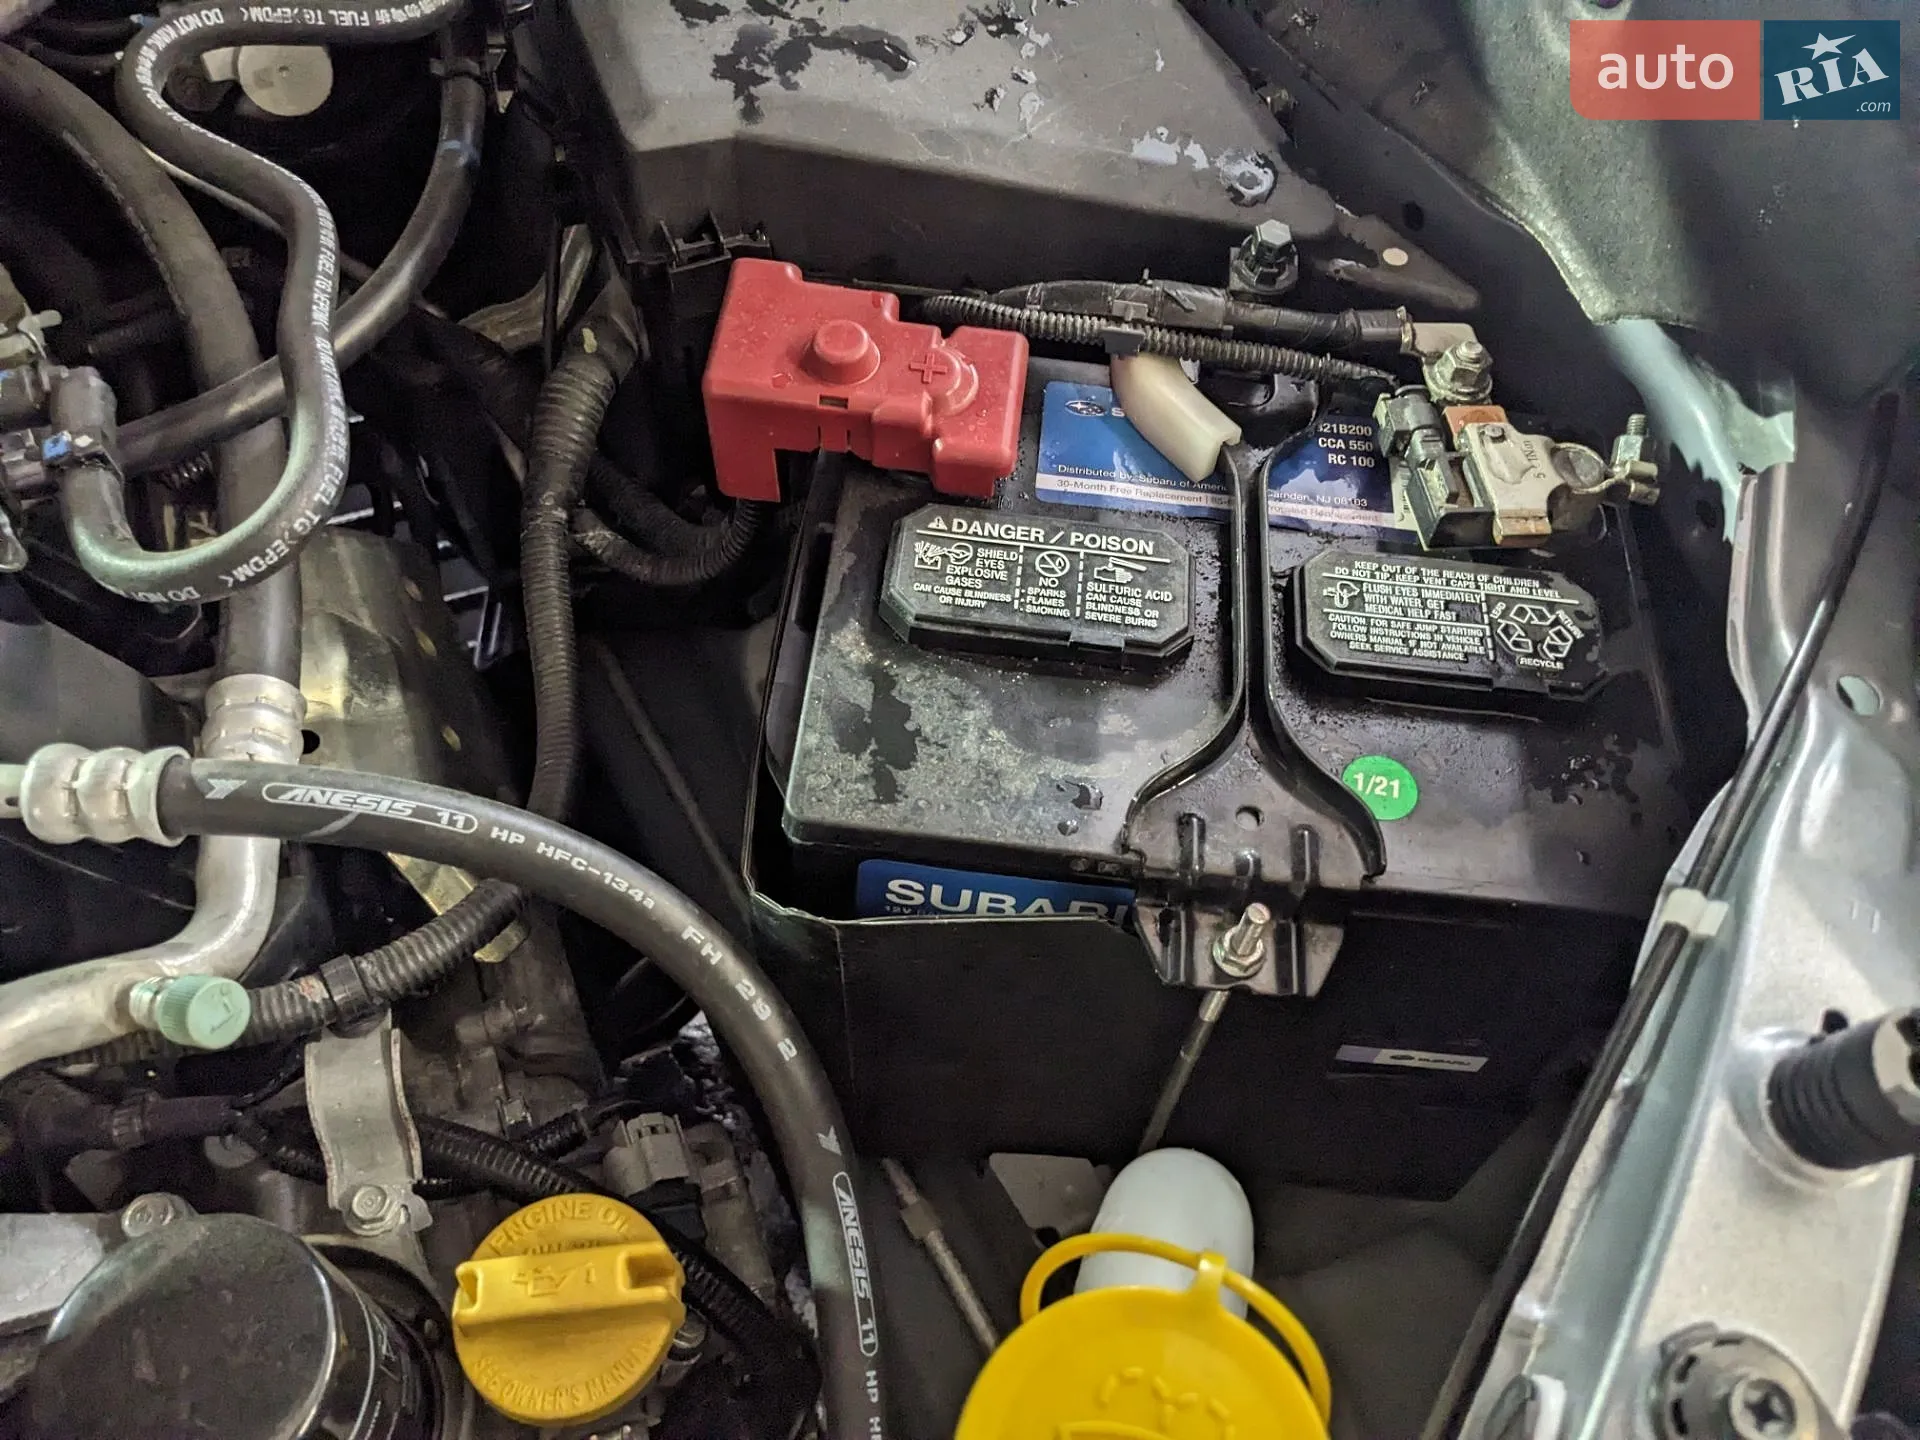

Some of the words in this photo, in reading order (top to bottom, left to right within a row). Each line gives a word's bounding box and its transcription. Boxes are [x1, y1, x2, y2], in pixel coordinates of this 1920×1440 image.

[173, 13, 202, 36] NOT
[201, 8, 224, 26] DO
[327, 10, 370, 26] FUEL
[318, 247, 336, 275] FUEL
[1318, 437, 1345, 450] CCA
[1349, 440, 1374, 452] 550
[1328, 453, 1347, 465] RC
[1350, 455, 1375, 468] 100
[313, 462, 344, 506] FUEL
[1058, 464, 1117, 479] Distributed
[1139, 474, 1176, 487] Subaru
[1179, 479, 1190, 488] of
[1056, 478, 1107, 494] 30-Month
[1109, 485, 1132, 495] Free
[1316, 494, 1331, 504] NJ
[293, 509, 321, 536] TG
[952, 518, 1045, 543] DANGER
[1070, 531, 1155, 556] POISON
[976, 547, 1018, 561] SHIELD
[946, 564, 1008, 581] EXPLOSIVE
[976, 558, 1005, 570] EYES
[945, 575, 982, 589] GASES
[1038, 577, 1059, 588] NO
[1335, 566, 1349, 576] DO
[1352, 569, 1371, 578] NOT
[1396, 574, 1420, 584] KEEP
[1422, 576, 1446, 586] VENT
[1450, 579, 1476, 589] CAPS
[1480, 582, 1506, 593] TIGHT
[1510, 586, 1530, 595] AND
[1533, 588, 1561, 598] LEVEL
[1354, 560, 1379, 571] KEEP
[1381, 564, 1401, 574] OUT
[1405, 566, 1417, 575] OF
[1421, 567, 1440, 577] THE
[1442, 569, 1474, 581] REACH
[1477, 574, 1490, 583] OF
[1493, 575, 1540, 588] CHILDREN
[913, 582, 931, 593] CAN
[933, 585, 962, 597] CAUSE
[964, 588, 1012, 603] BLINDNESS
[1027, 587, 1066, 599] SPARKS
[1085, 593, 1107, 603] CAN
[1109, 596, 1142, 608] CAUSE
[1086, 582, 1142, 598] SULFURIC
[1145, 590, 1173, 602] ACID
[1362, 583, 1393, 595] FLUSH
[1395, 586, 1418, 598] EYES
[1421, 589, 1481, 604] IMMEDIATELY
[939, 595, 953, 605] OR
[955, 597, 987, 608] INJURY
[1026, 596, 1065, 608] FLAMES
[1086, 602, 1141, 616] BLINDNESS
[1144, 609, 1159, 619] OR
[1363, 593, 1388, 604] WITH
[1426, 600, 1445, 610] GET
[1025, 605, 1071, 618] SMOKING
[1085, 611, 1121, 624] SEVERE
[1124, 616, 1158, 628] BURNS
[1364, 603, 1404, 617] MEDICAL
[1408, 607, 1431, 618] HELP
[1434, 611, 1457, 622] FAST
[1332, 622, 1367, 634] FOLLOW
[1370, 627, 1432, 641] INSTRUCTIONS
[1434, 632, 1443, 642] IN
[1445, 634, 1481, 646] VEHICLE
[1370, 617, 1388, 627] FOR
[1391, 619, 1412, 630] SAFE
[1415, 623, 1438, 633] JUMP
[1440, 626, 1483, 637] STARTING
[1330, 630, 1367, 642] OWNERS
[1408, 639, 1417, 648] IF
[1420, 640, 1438, 649] NOT
[1441, 642, 1485, 655] AVAILABLE
[1349, 640, 1372, 651] SEEK
[1374, 643, 1409, 656] SERVICE
[1520, 657, 1565, 670] RECYCLE
[1353, 772, 1400, 800] 1/21
[436, 809, 467, 829] 11
[491, 826, 526, 845] HP
[536, 841, 656, 910] HFC-134a
[680, 924, 723, 967] FH
[487, 1199, 593, 1257] ENGINE
[861, 1317, 875, 1345] 11
[502, 1378, 582, 1413] OWNER'S
[866, 1370, 879, 1403] HP
